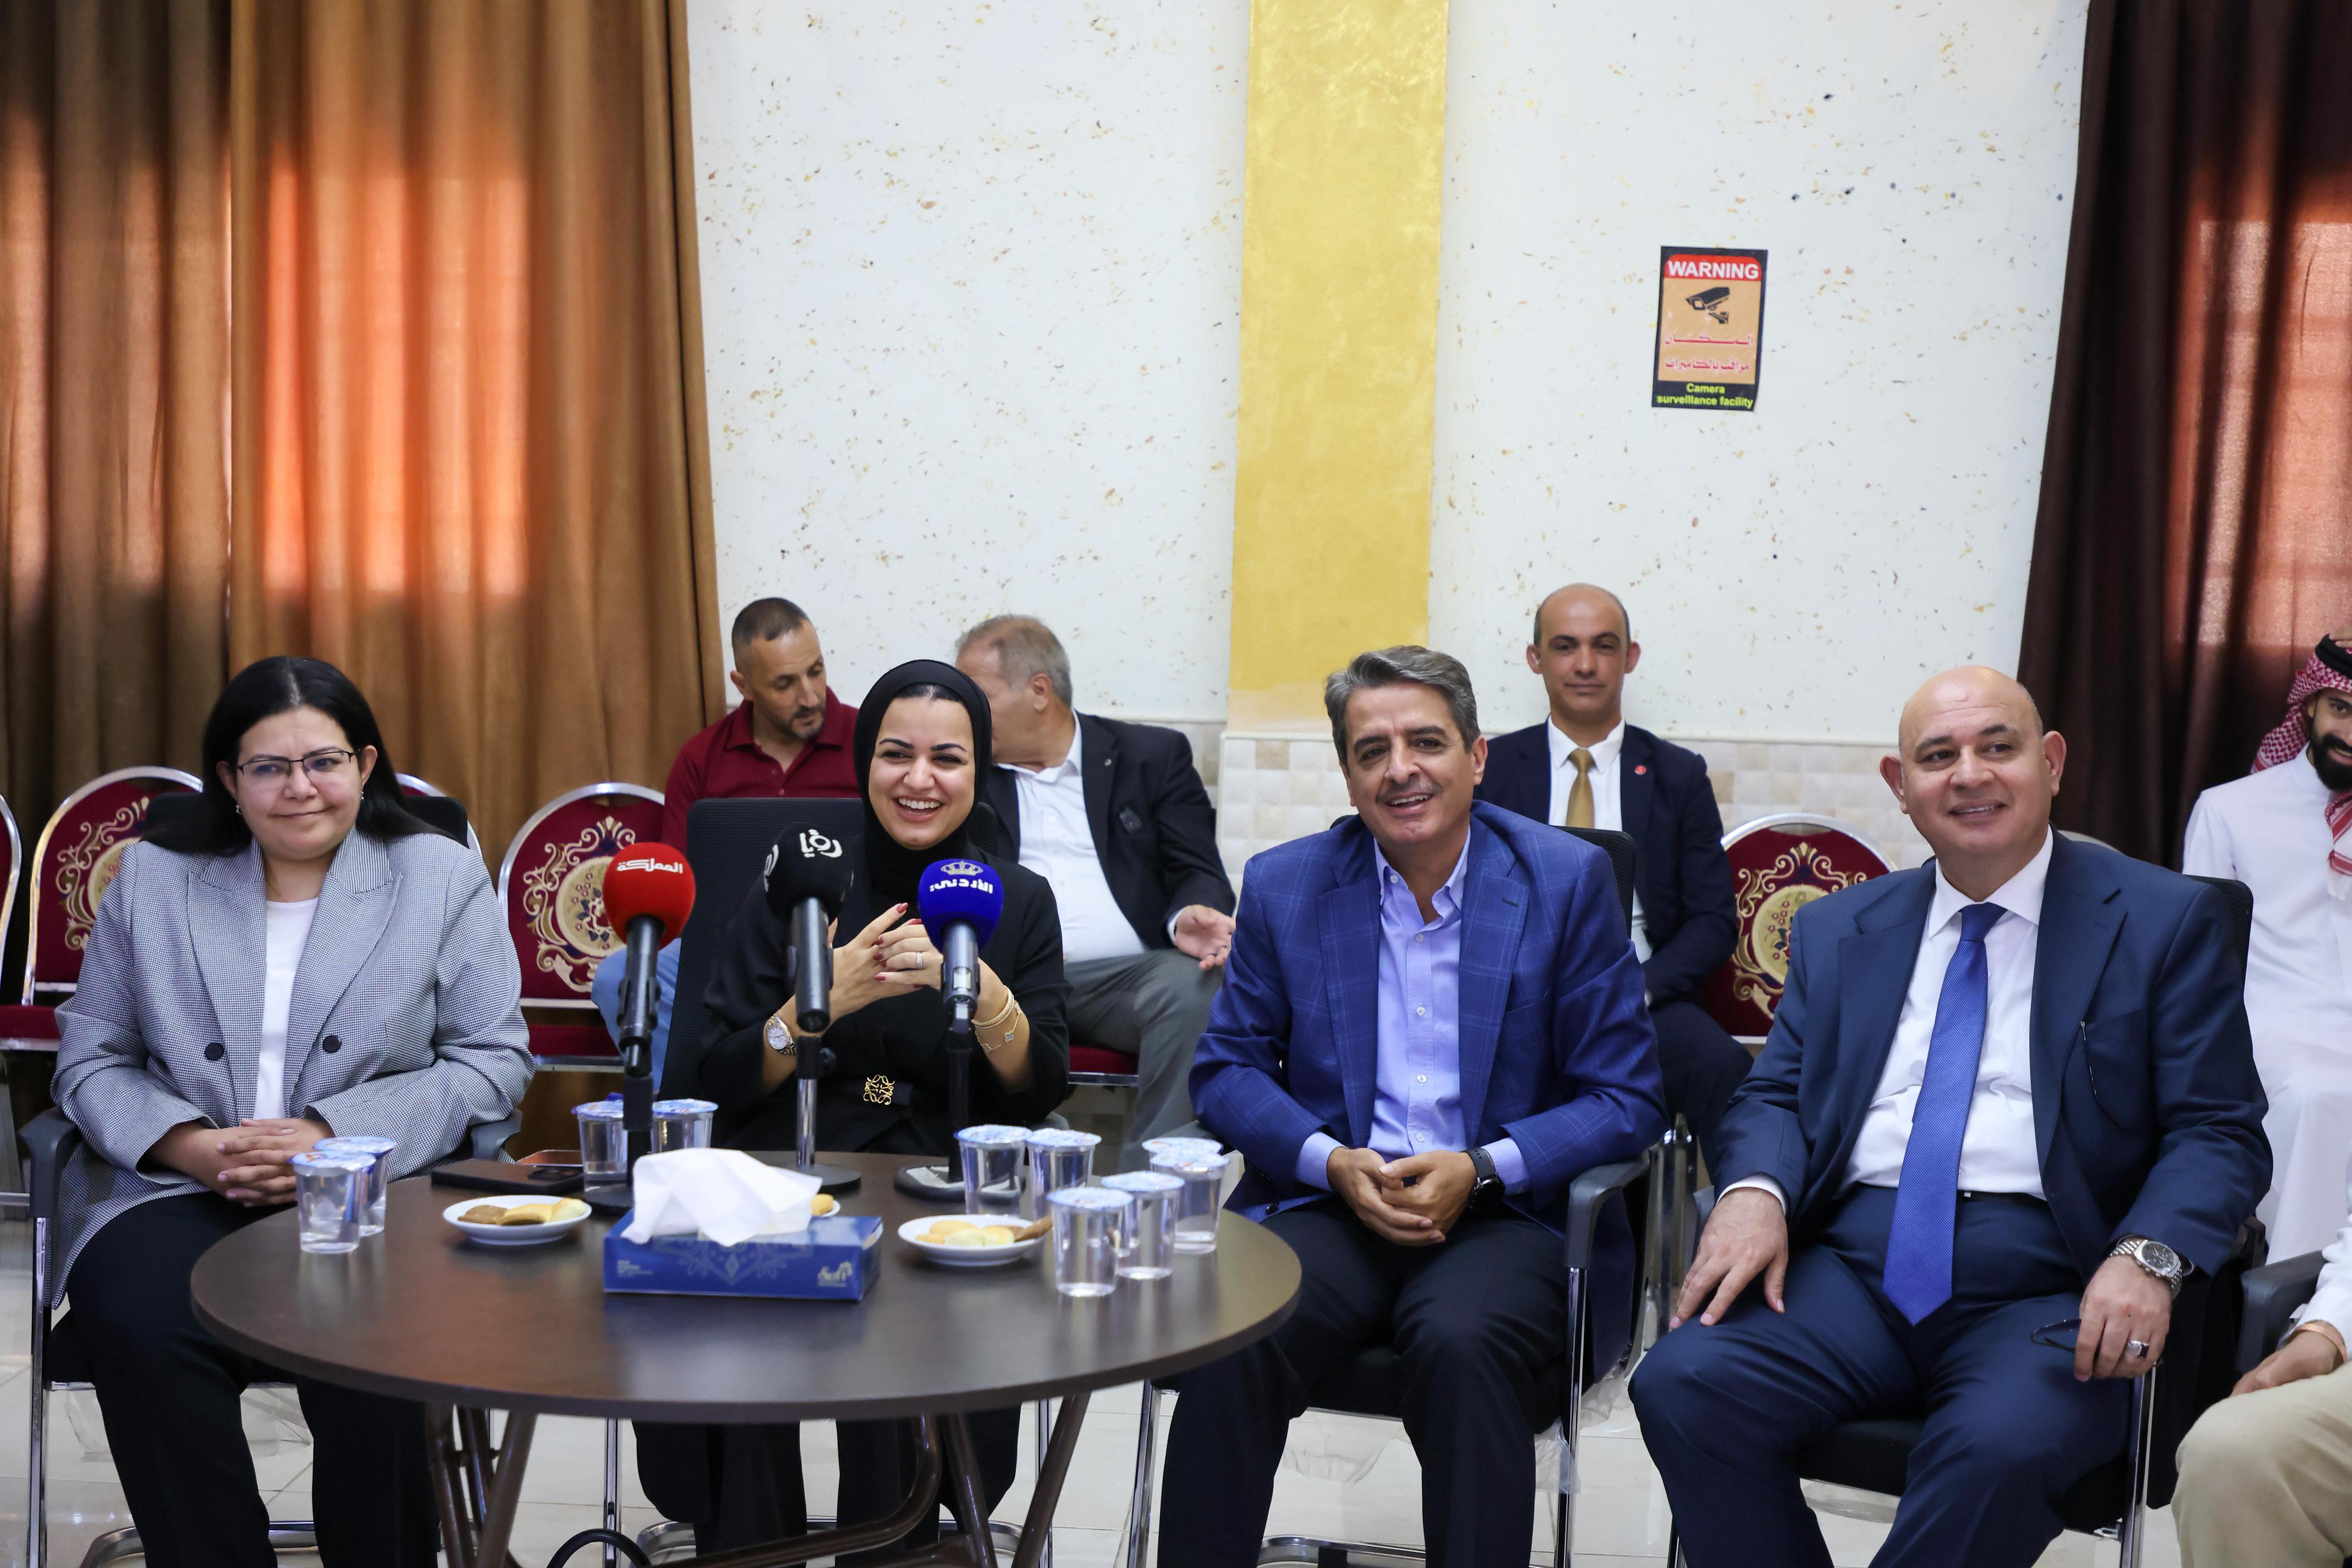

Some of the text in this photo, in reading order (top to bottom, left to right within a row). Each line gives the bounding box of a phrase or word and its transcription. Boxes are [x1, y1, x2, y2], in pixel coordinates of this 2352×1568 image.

[1668, 261, 1759, 279] WARNING
[1664, 332, 1753, 345] المكان
[1665, 357, 1750, 373] مراقب بالكاميرات
[1686, 383, 1726, 395] Camera
[1656, 395, 1754, 409] surveillance facility
[799, 829, 842, 858] رؤيا
[617, 857, 683, 874] المملكة
